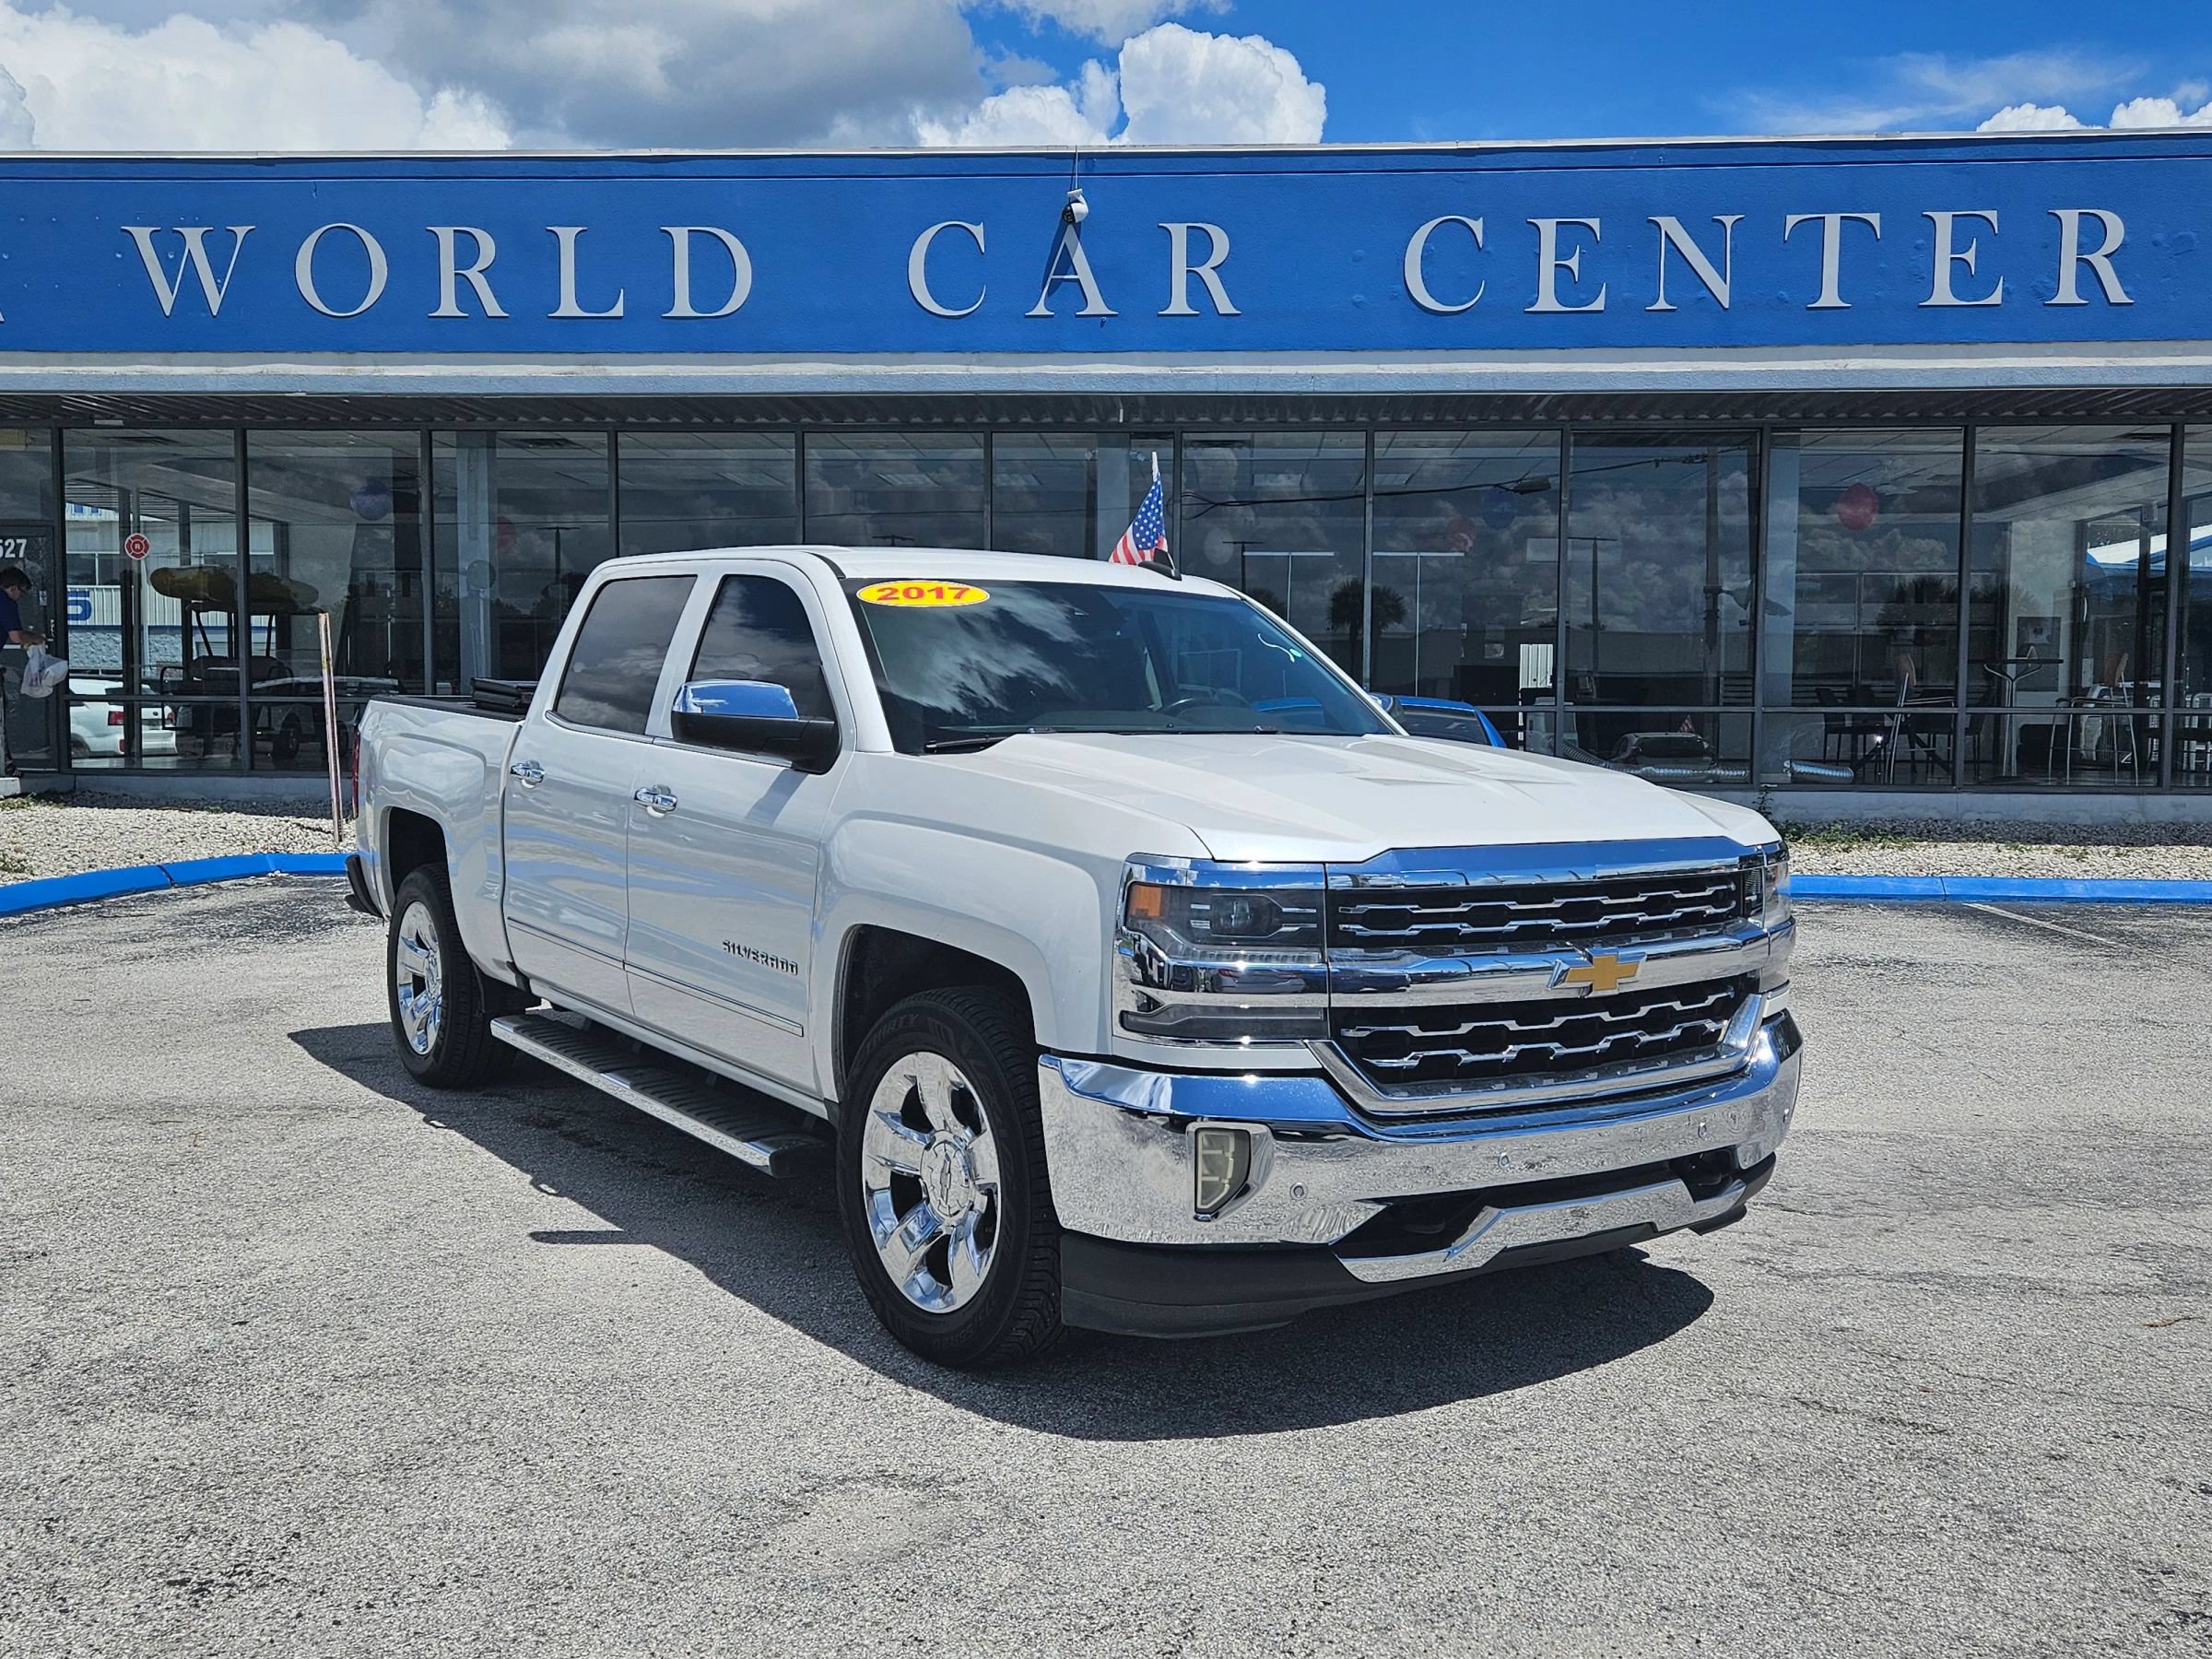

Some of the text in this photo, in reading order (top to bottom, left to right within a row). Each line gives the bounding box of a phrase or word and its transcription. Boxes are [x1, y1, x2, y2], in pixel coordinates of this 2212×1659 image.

[122, 209, 2134, 318] WORLD CAR CENTER
[877, 586, 971, 601] 2017
[723, 939, 799, 977] SILVERADO
